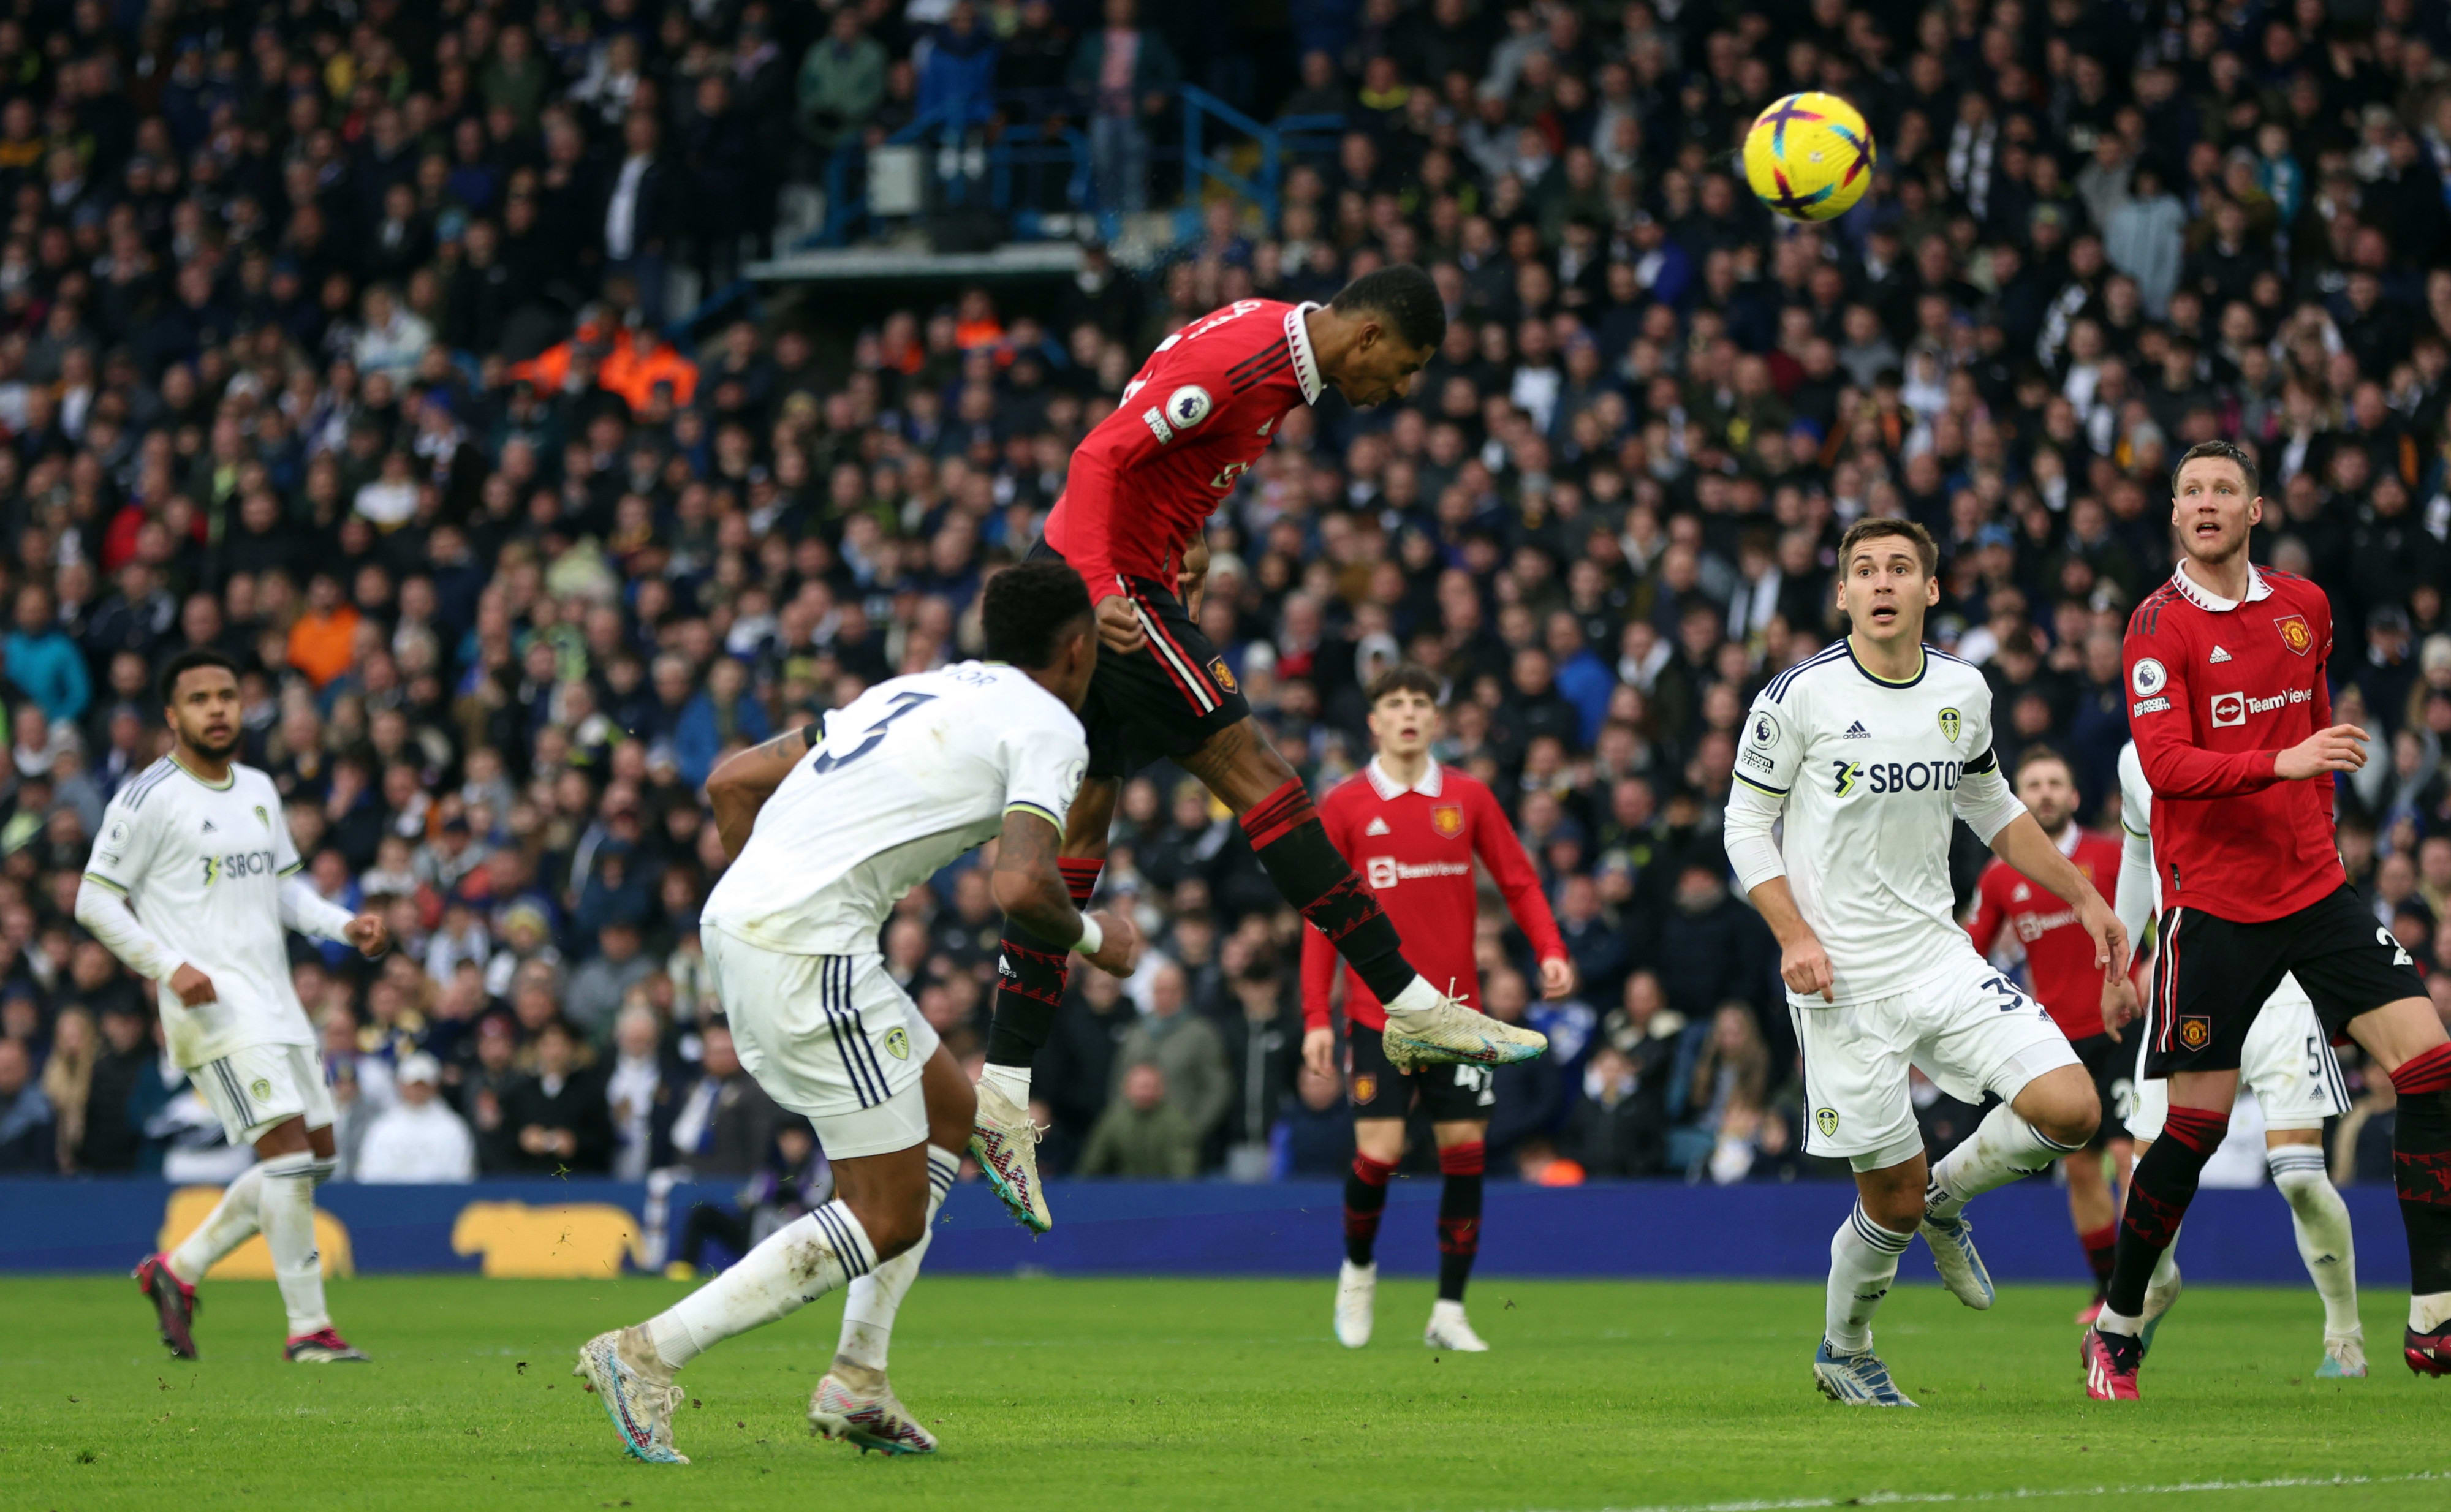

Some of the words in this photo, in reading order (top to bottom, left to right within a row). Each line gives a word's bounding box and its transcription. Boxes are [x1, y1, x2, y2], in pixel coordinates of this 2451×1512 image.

[2209, 654, 2233, 663] adidas
[2143, 697, 2166, 708] room
[2144, 702, 2171, 714] racism
[813, 691, 939, 775] 3
[1843, 731, 1871, 740] adidas
[1751, 752, 1771, 767] room
[2306, 1037, 2322, 1078] 5
